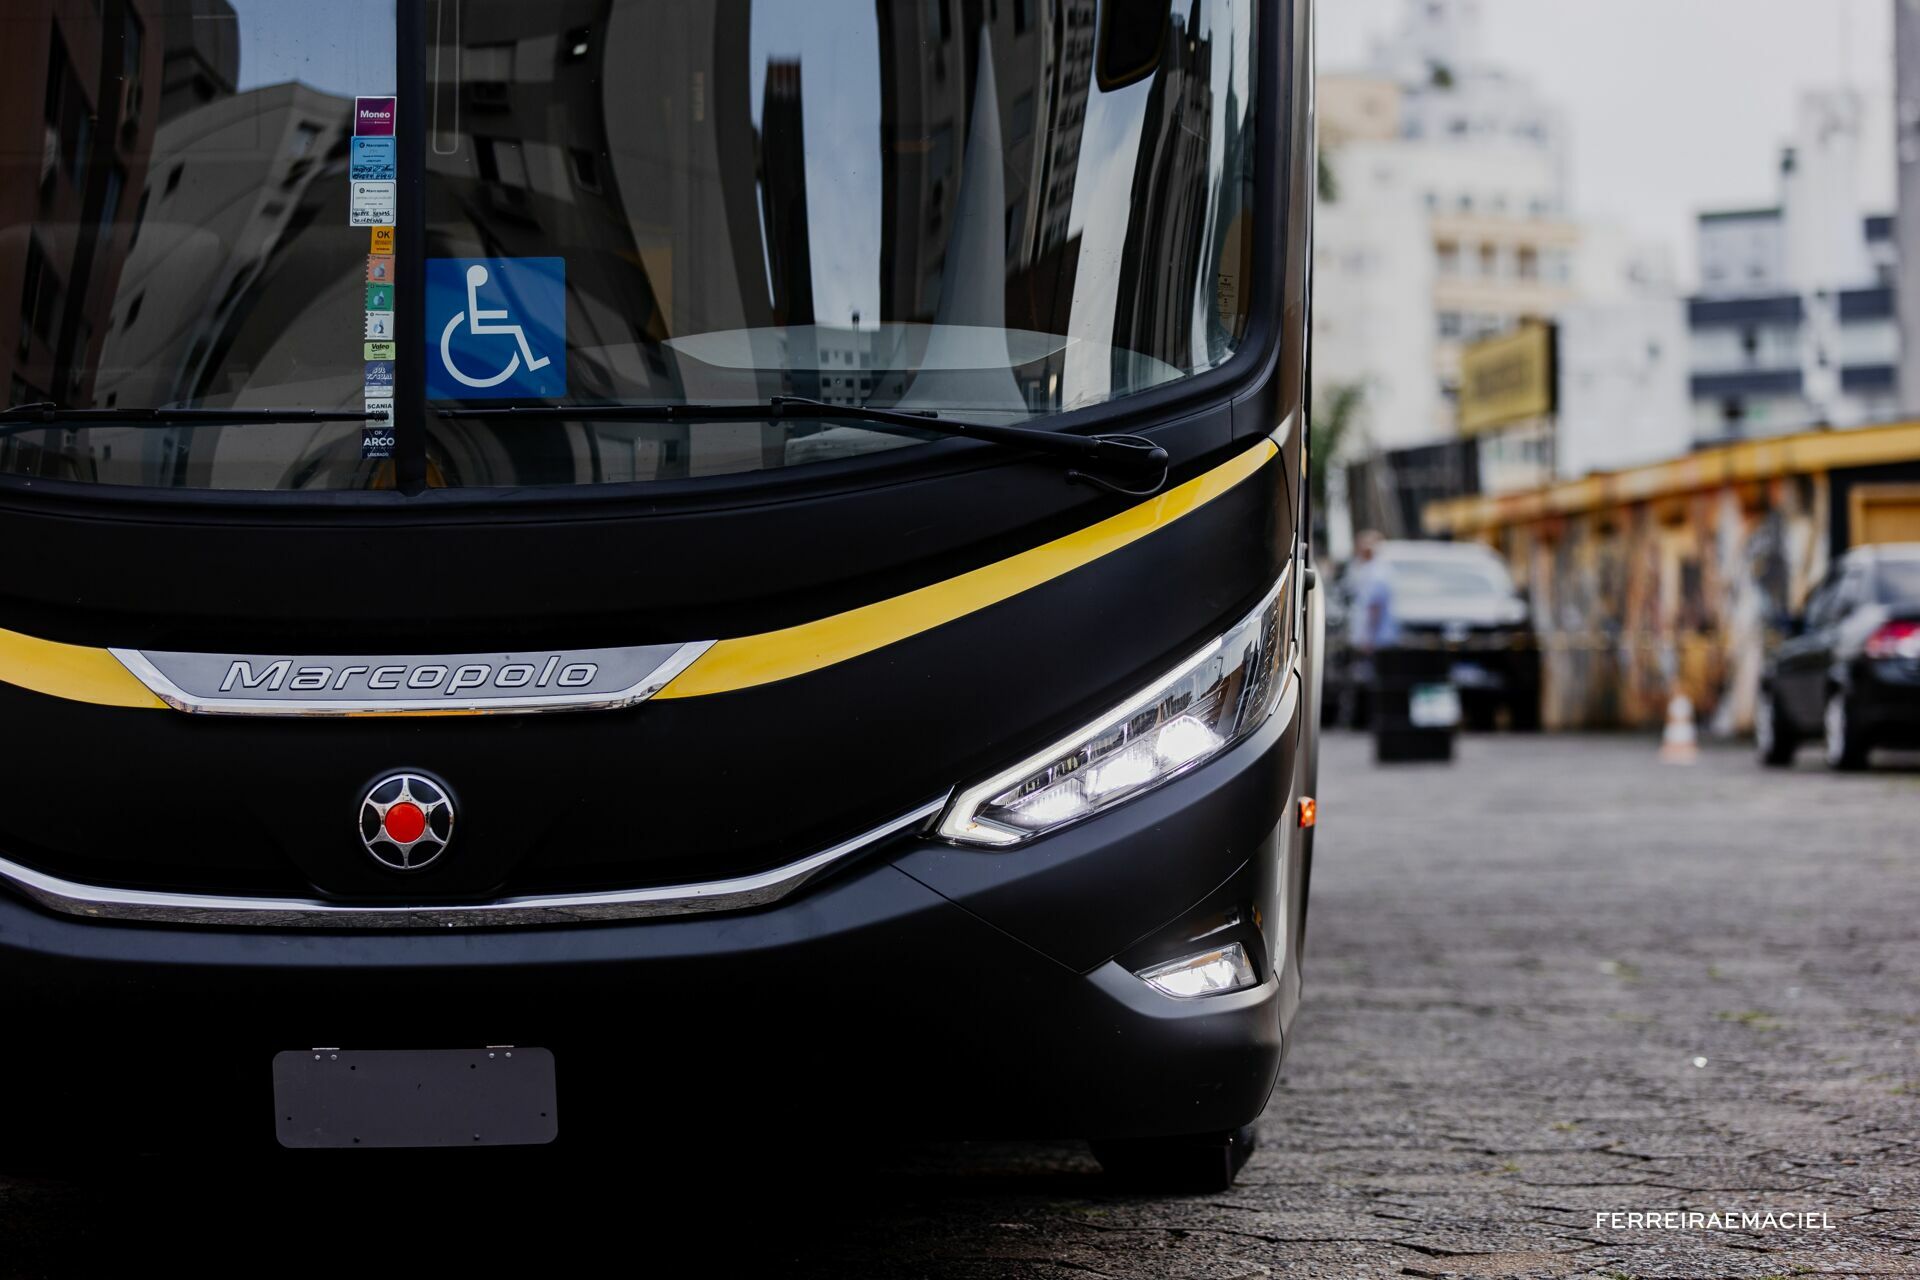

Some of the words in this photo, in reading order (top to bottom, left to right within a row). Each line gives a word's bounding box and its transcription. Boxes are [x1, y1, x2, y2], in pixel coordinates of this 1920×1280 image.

[360, 110, 391, 118] Moneo
[377, 230, 390, 239] OK
[363, 437, 395, 446] ARCO
[219, 655, 599, 696] Marcopolo
